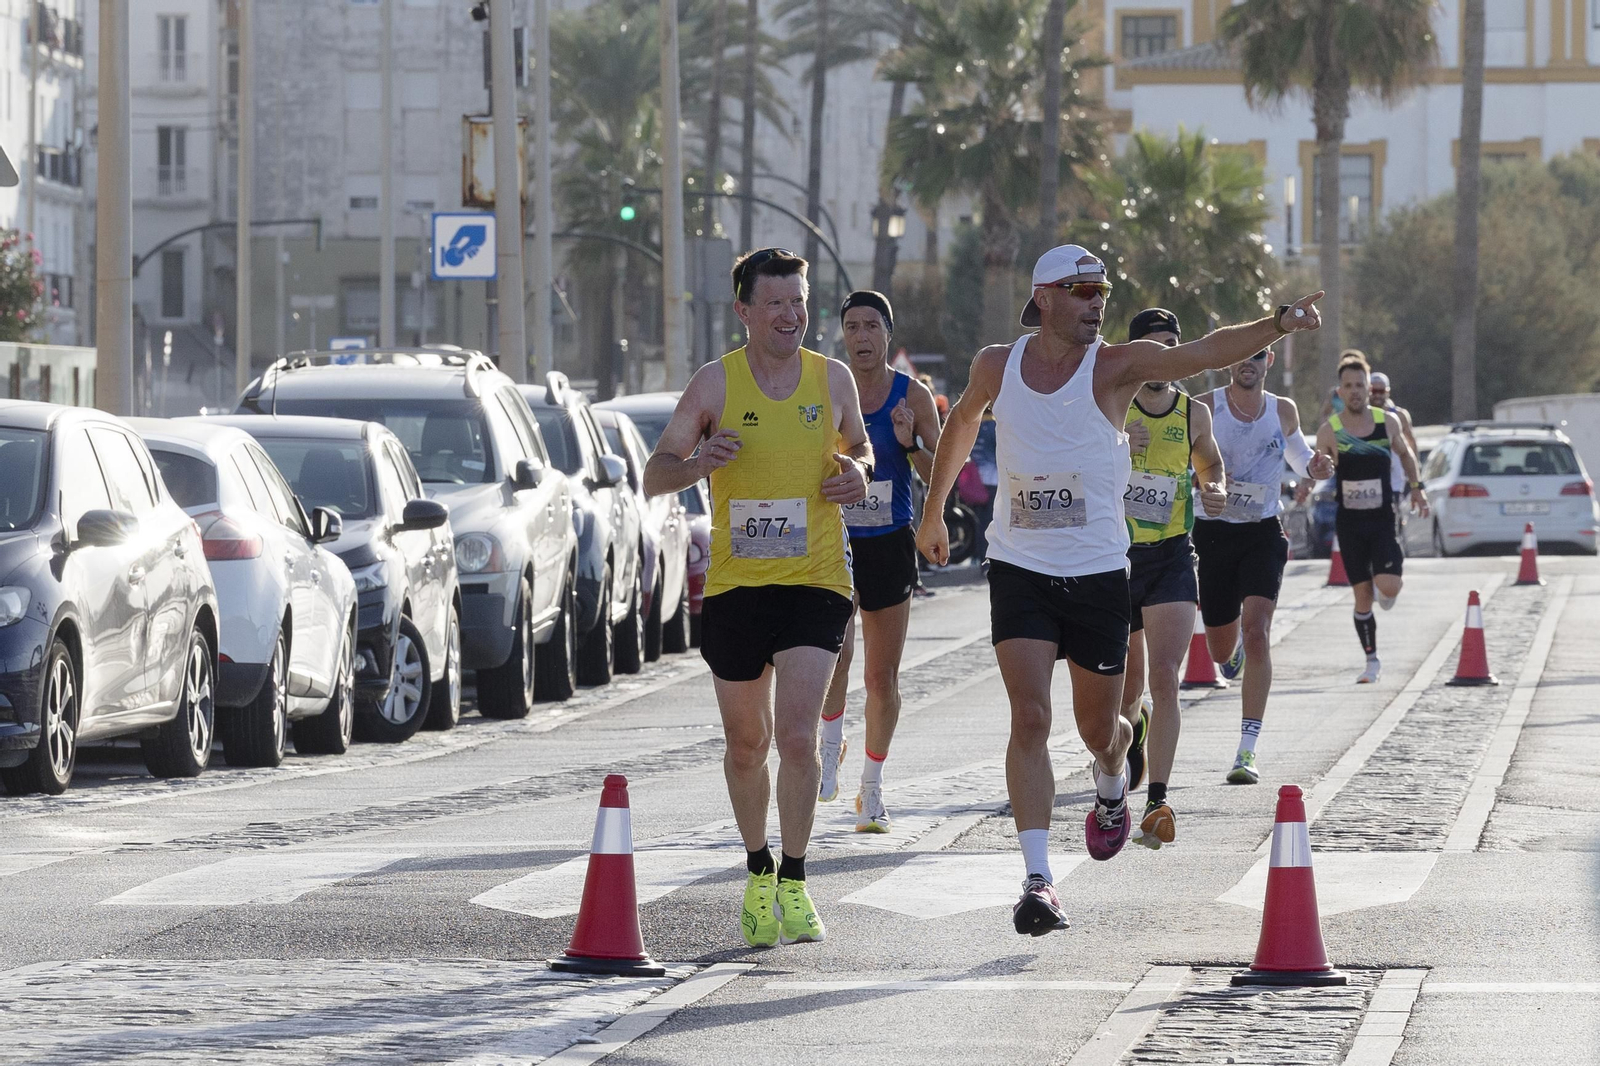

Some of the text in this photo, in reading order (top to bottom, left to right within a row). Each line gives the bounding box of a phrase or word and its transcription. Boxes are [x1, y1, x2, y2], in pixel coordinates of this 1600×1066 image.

[1017, 488, 1073, 511] 1579
[1123, 483, 1168, 507] 2283
[746, 517, 788, 538] 677
